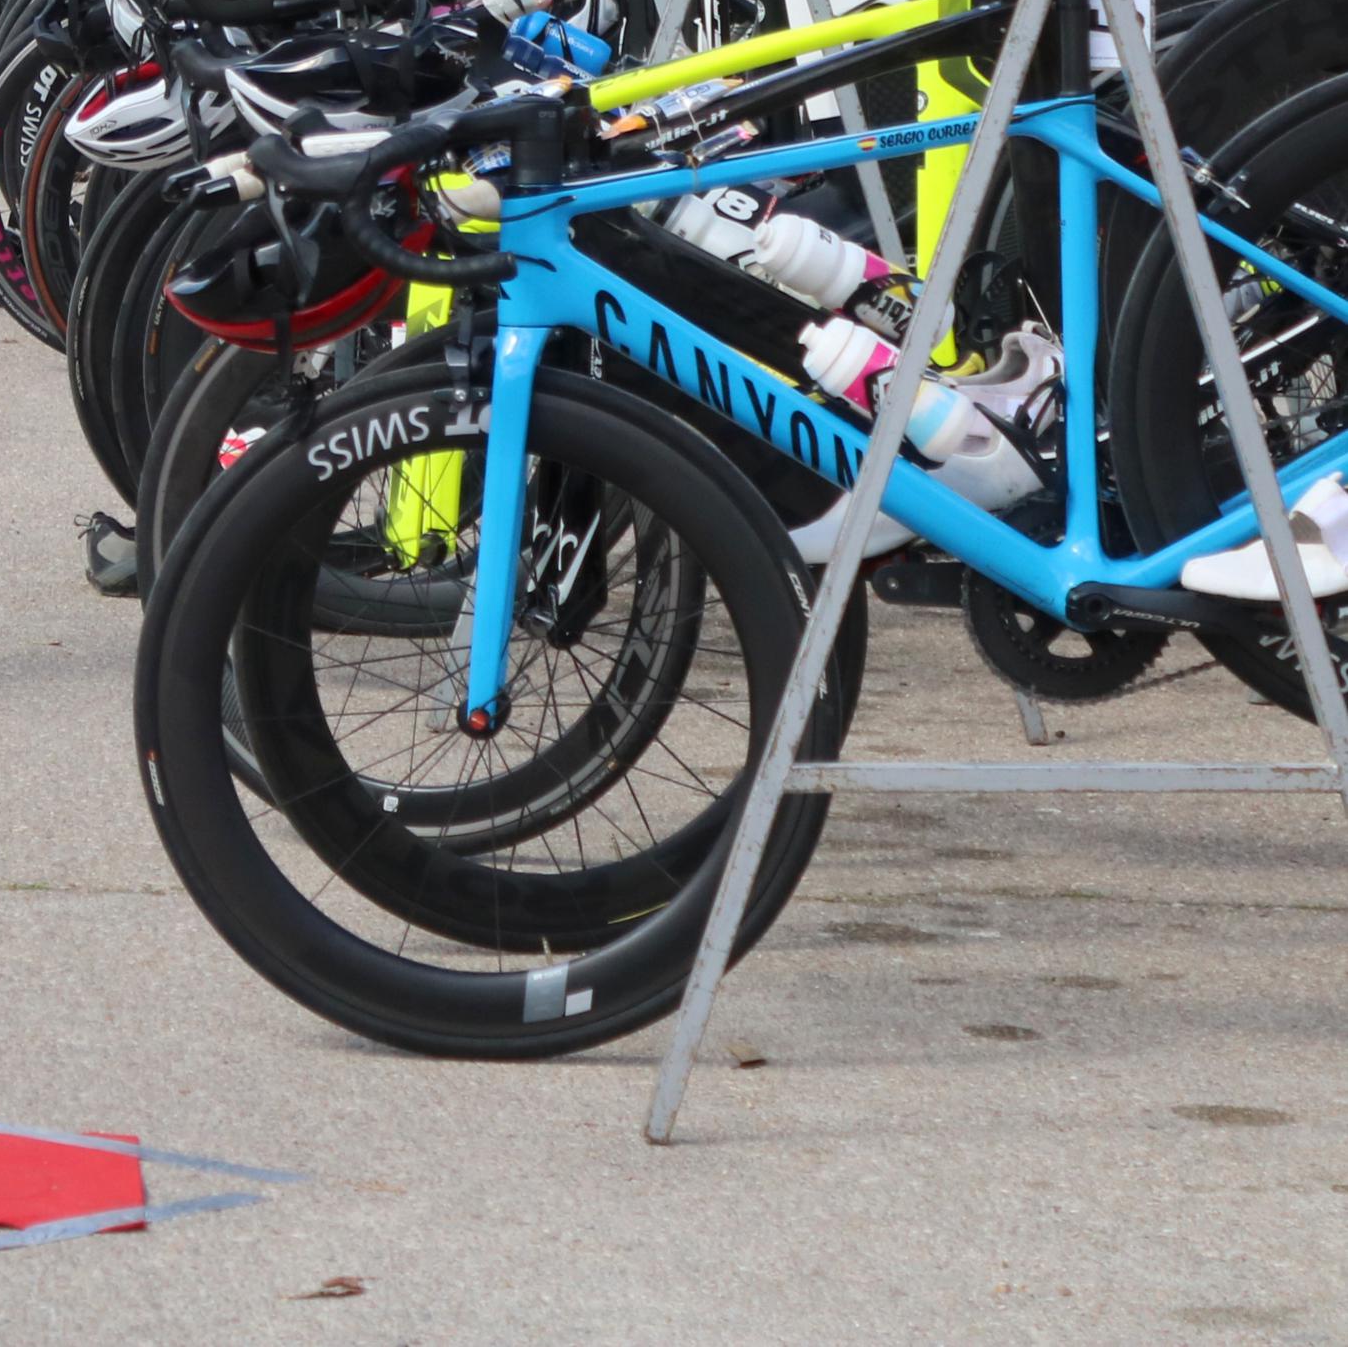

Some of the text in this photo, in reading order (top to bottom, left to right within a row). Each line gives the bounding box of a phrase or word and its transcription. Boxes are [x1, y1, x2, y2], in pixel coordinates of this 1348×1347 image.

[19, 103, 43, 167] SWISS
[879, 130, 925, 149] SERGIO
[594, 289, 863, 493] CANYON
[307, 405, 431, 482] SWISS
